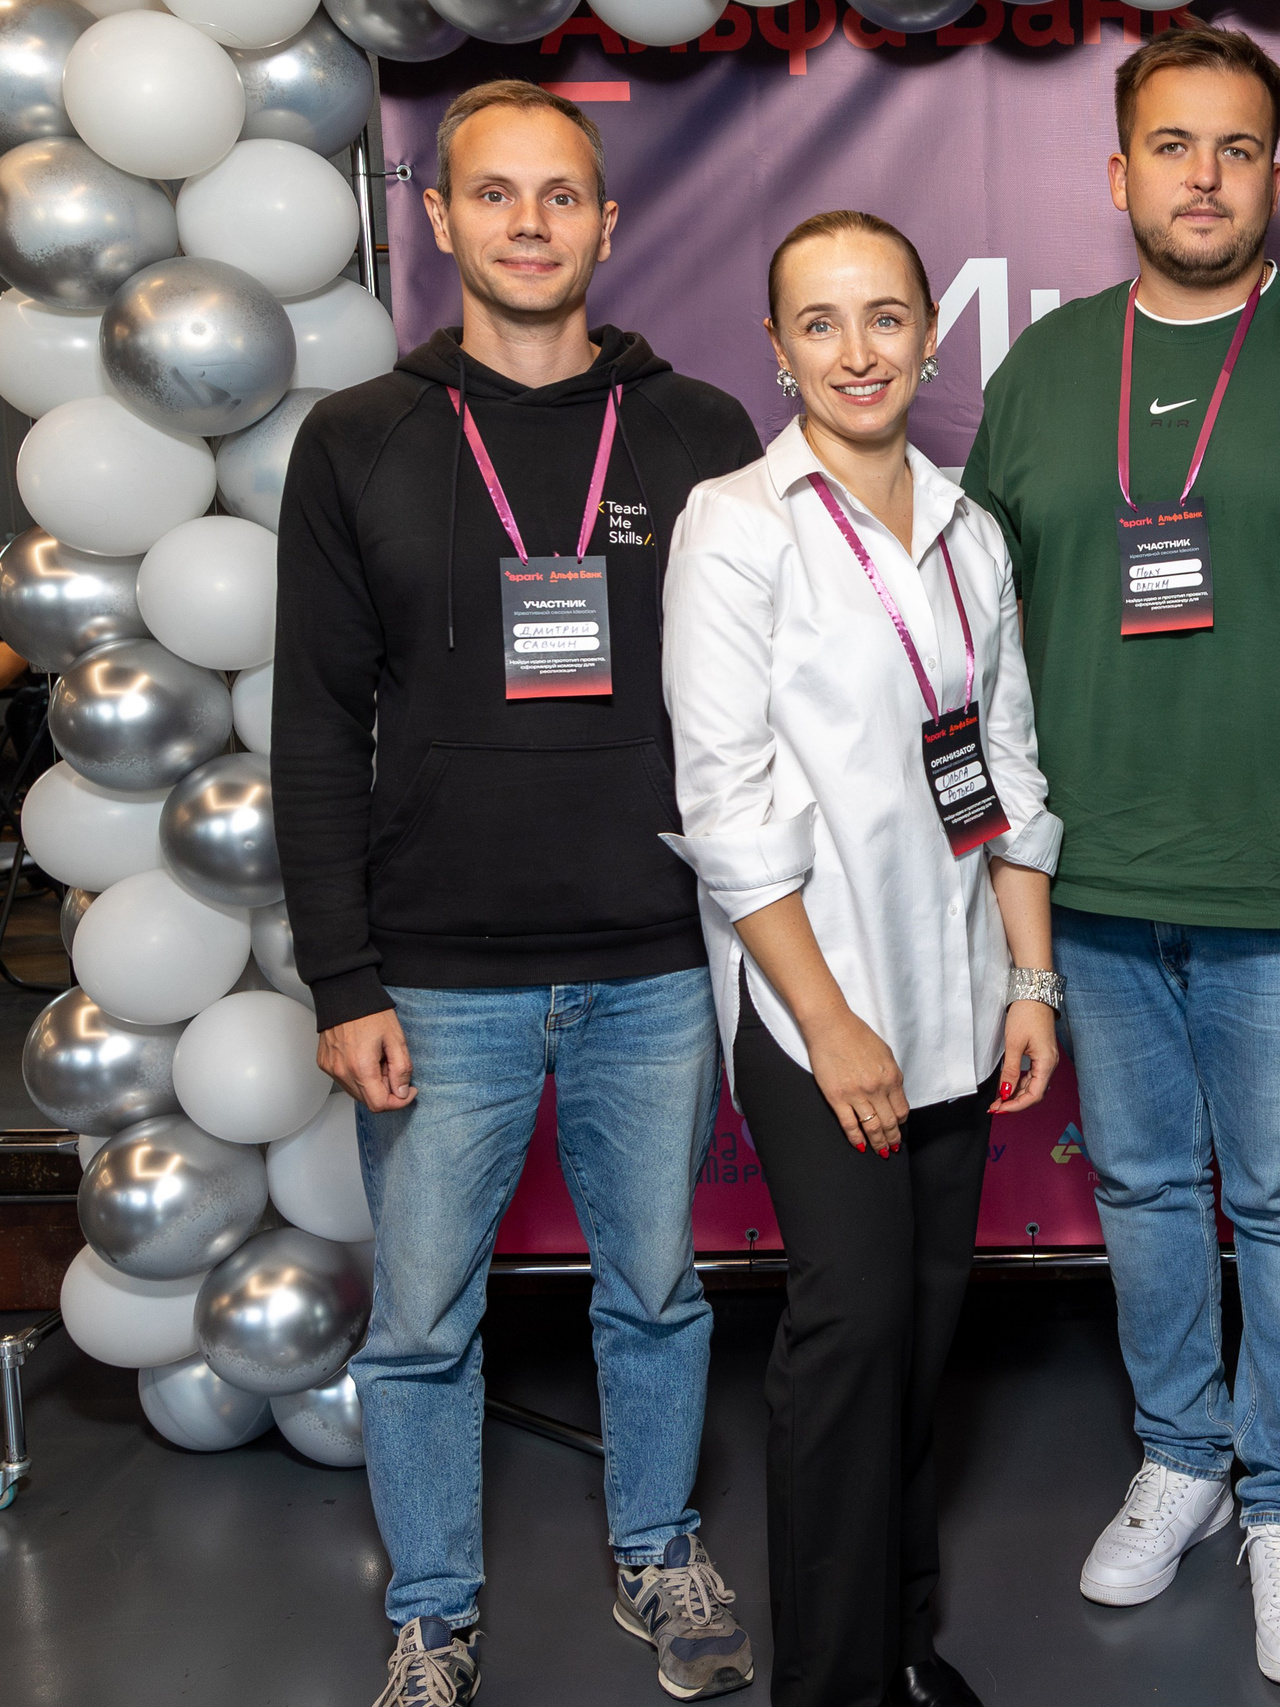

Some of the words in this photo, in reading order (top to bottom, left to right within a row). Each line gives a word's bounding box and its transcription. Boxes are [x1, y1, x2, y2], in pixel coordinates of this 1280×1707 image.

[610, 515, 632, 529] Me
[1137, 539, 1191, 552] УЧАСТНИК
[523, 600, 586, 609] УЧАСТНИК
[520, 623, 590, 637] ДМИТРИЙ
[931, 743, 976, 768] ОРГАНИЗАТОР
